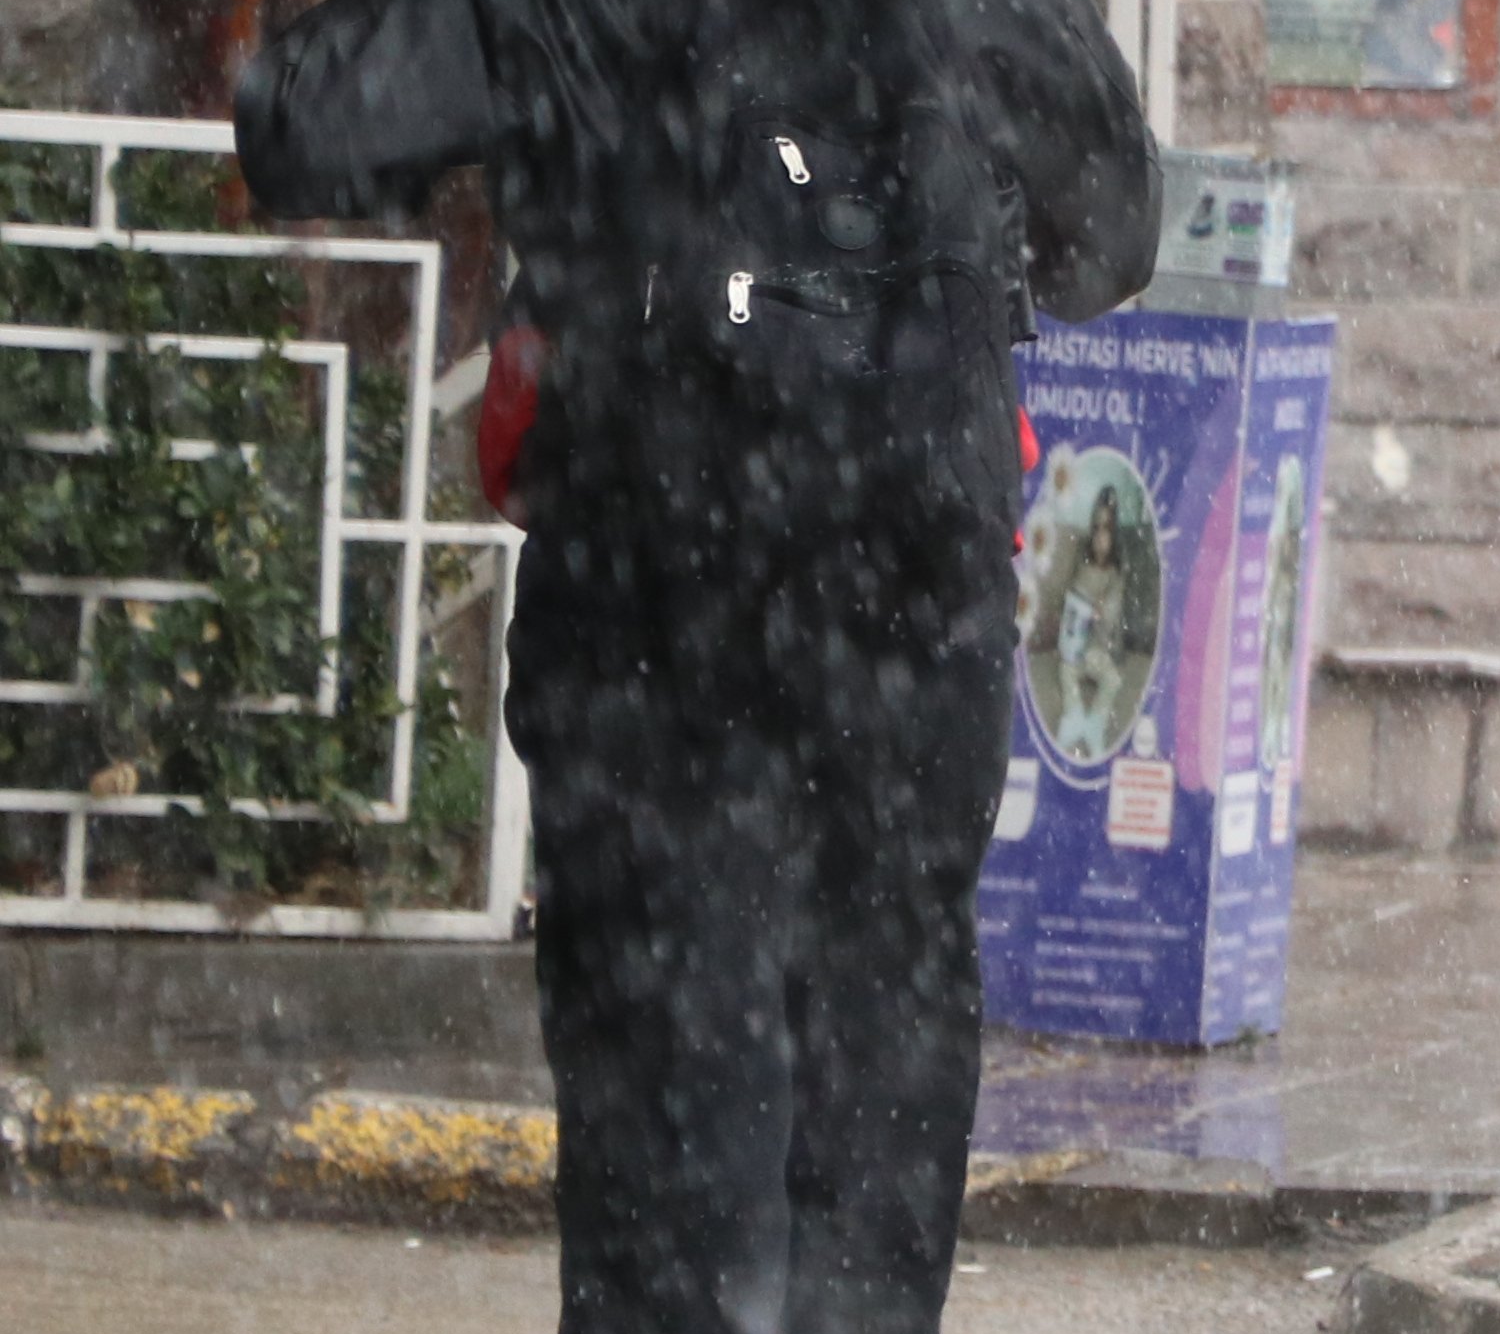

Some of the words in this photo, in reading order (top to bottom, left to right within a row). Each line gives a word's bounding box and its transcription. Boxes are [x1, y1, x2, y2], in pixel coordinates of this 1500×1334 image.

[1036, 329, 1119, 369] HASTASI
[1124, 337, 1196, 378] MERVE
[1025, 384, 1100, 423] UMUDU
